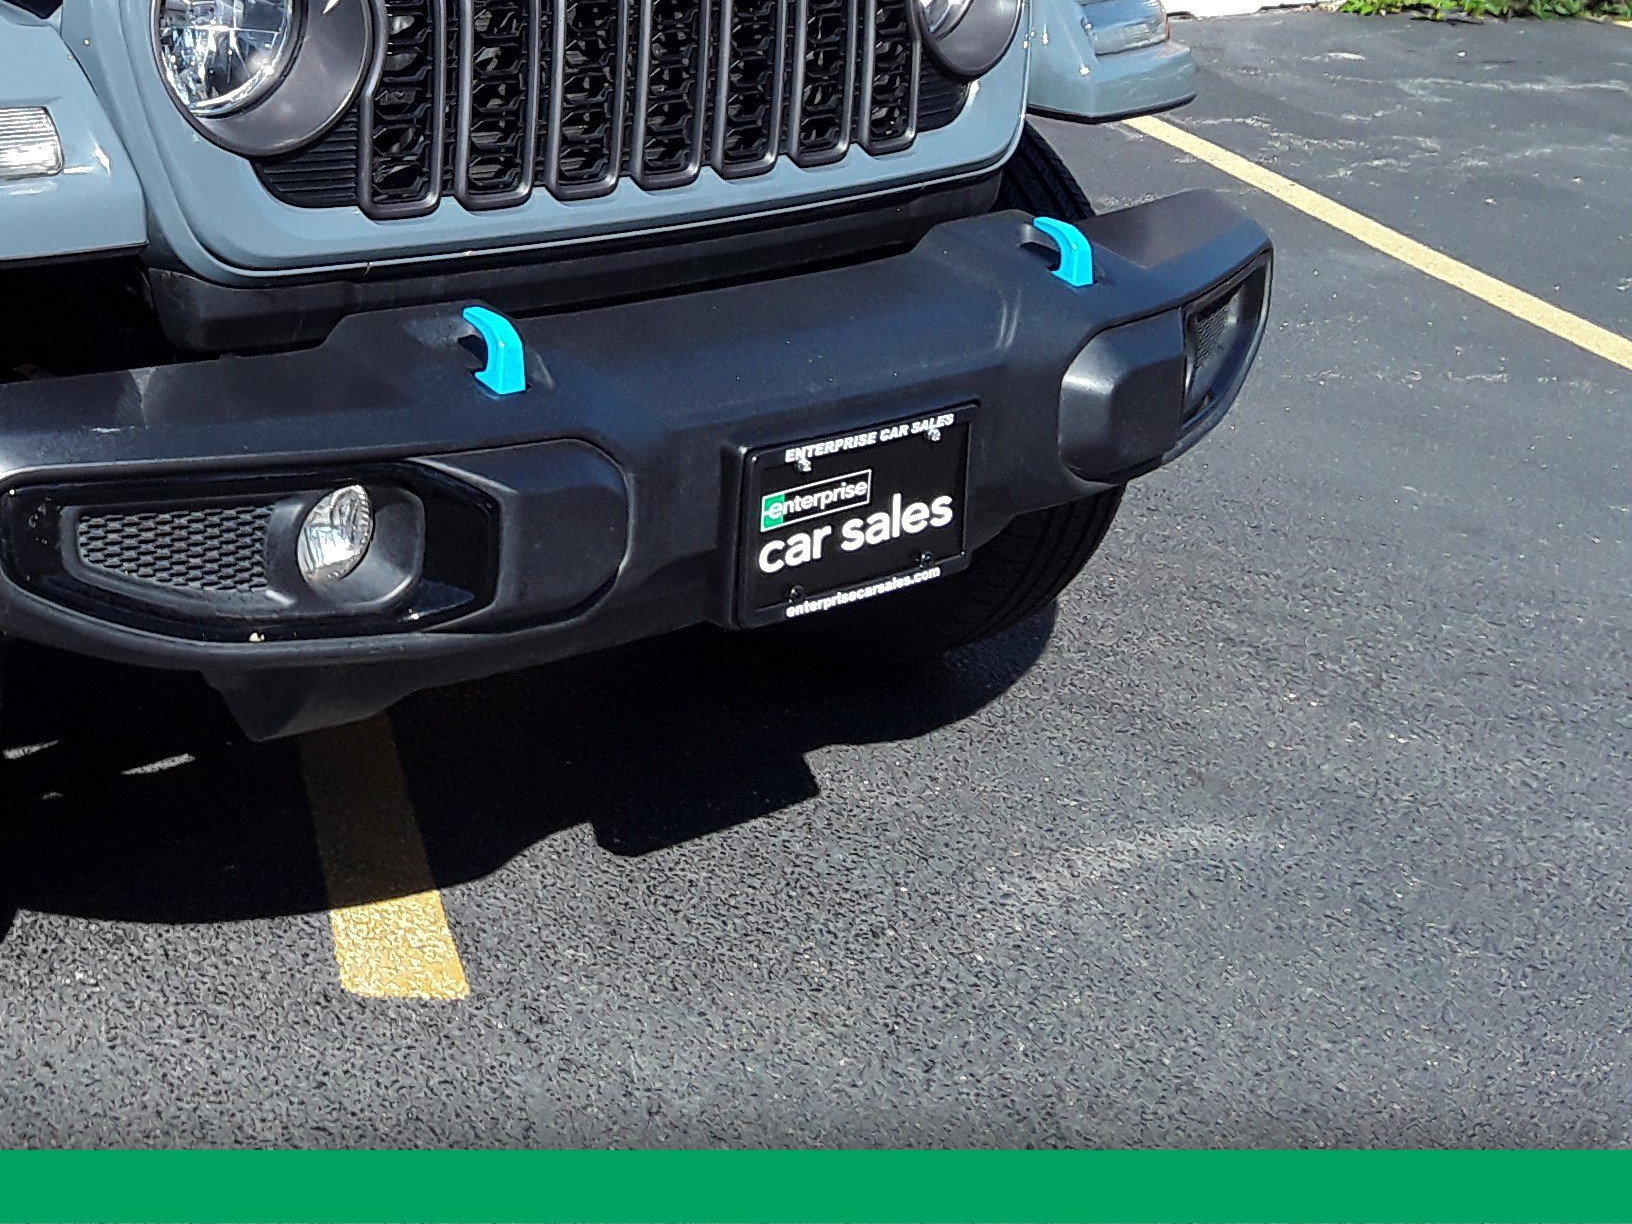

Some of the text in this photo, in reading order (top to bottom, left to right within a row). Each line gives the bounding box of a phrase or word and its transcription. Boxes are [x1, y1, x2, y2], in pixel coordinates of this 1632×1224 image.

[784, 413, 955, 463] ENTERPRISE CAR SALES
[766, 481, 868, 519] enterprise
[758, 492, 954, 574] car sales
[786, 566, 941, 618] enterprisecarsales.com
